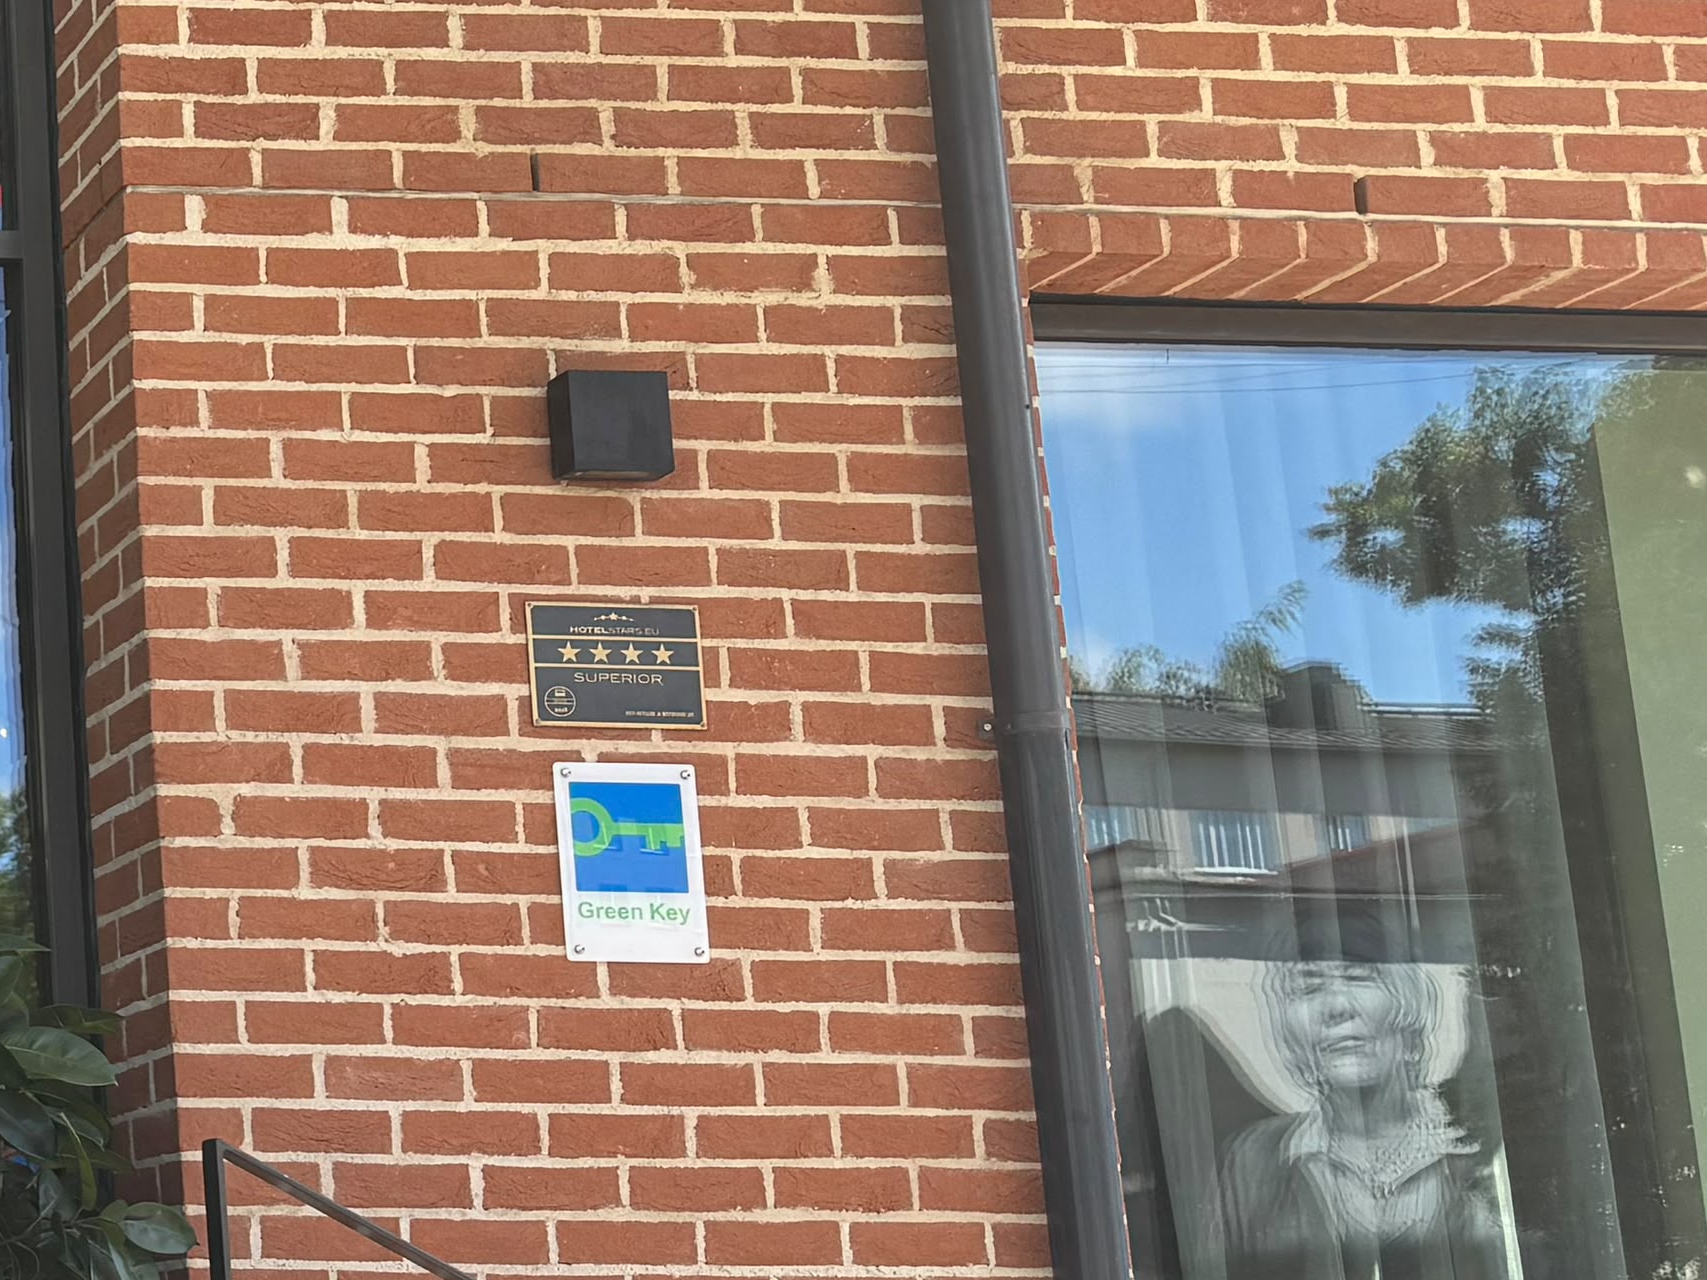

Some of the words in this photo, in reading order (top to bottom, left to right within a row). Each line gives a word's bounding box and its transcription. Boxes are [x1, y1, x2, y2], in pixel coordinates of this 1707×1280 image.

[573, 672, 664, 686] SUPERIOR
[577, 901, 644, 921] Green
[649, 902, 691, 926] Key
